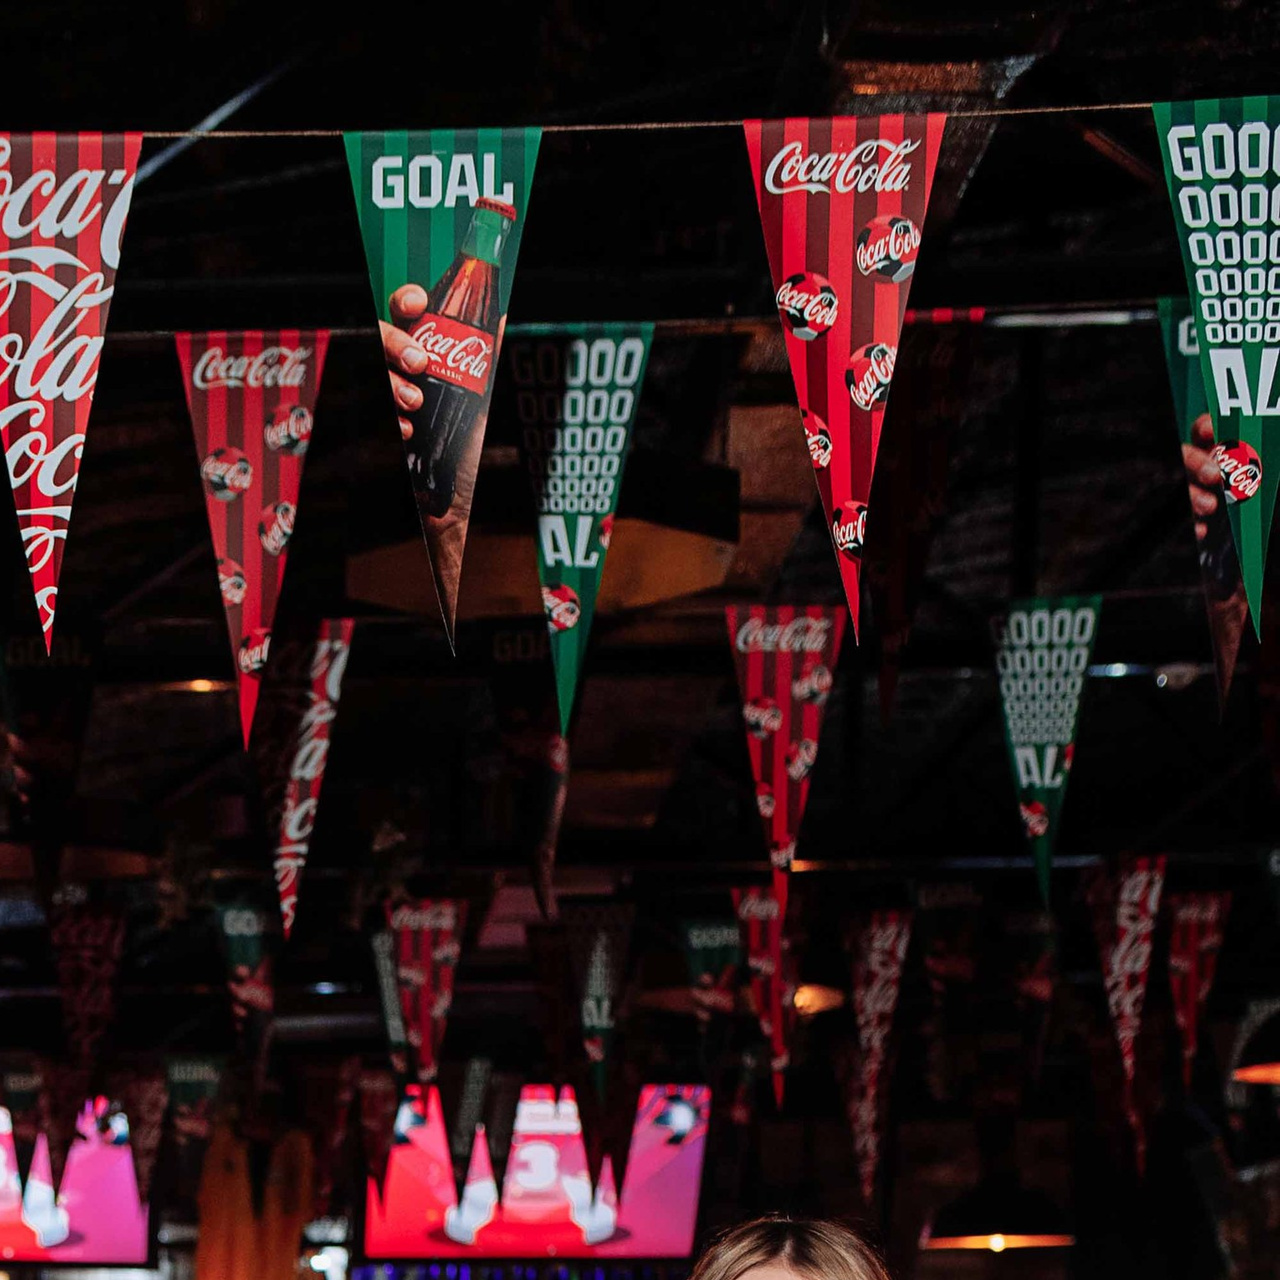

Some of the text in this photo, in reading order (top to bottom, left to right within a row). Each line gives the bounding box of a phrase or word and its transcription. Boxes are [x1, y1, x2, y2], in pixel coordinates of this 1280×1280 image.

[764, 138, 921, 195] Coca-Cola
[1167, 121, 1280, 181] GOO
[372, 152, 514, 209] GOAL
[193, 346, 312, 391] Coca-Cola
[410, 321, 488, 378] Coca-Cola
[431, 364, 463, 382] CLASSIC
[538, 514, 600, 568] AL
[1015, 746, 1064, 788] AL
[519, 1141, 558, 1190] 3
